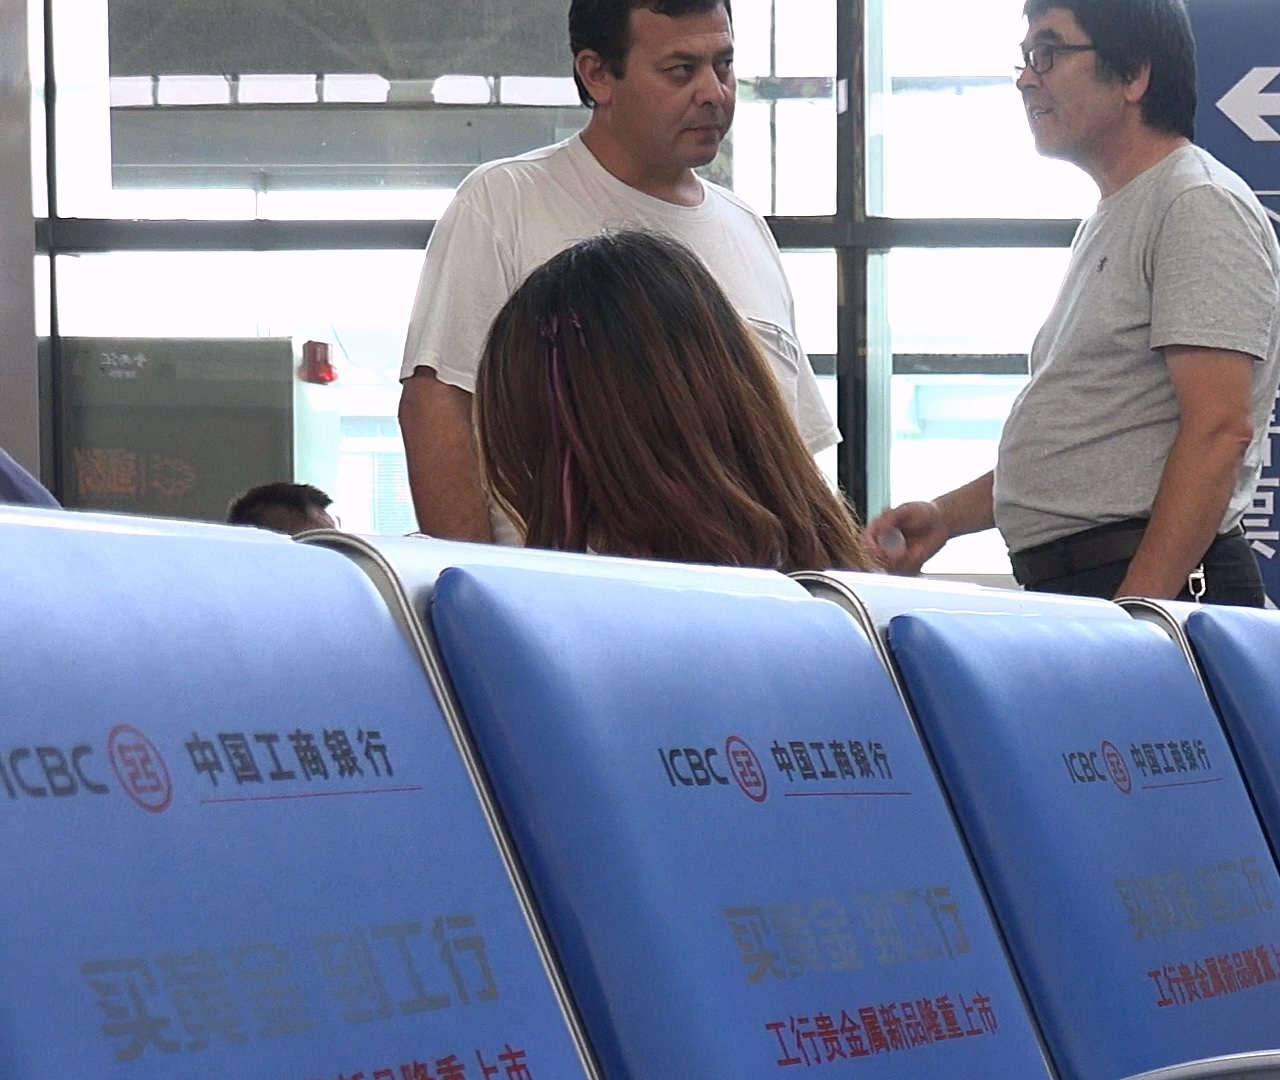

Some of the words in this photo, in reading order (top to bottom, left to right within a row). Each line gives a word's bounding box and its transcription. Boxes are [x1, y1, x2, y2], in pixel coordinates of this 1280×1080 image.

[0, 745, 109, 800] ICBC
[186, 728, 394, 786] 中国工商银行
[657, 747, 729, 787] ICBC
[770, 739, 894, 782] 中国工商银行
[1062, 751, 1108, 784] ICBC
[1128, 740, 1212, 777] 中国工商银行
[765, 991, 1000, 1067] 工行贵金属新品隆重上市
